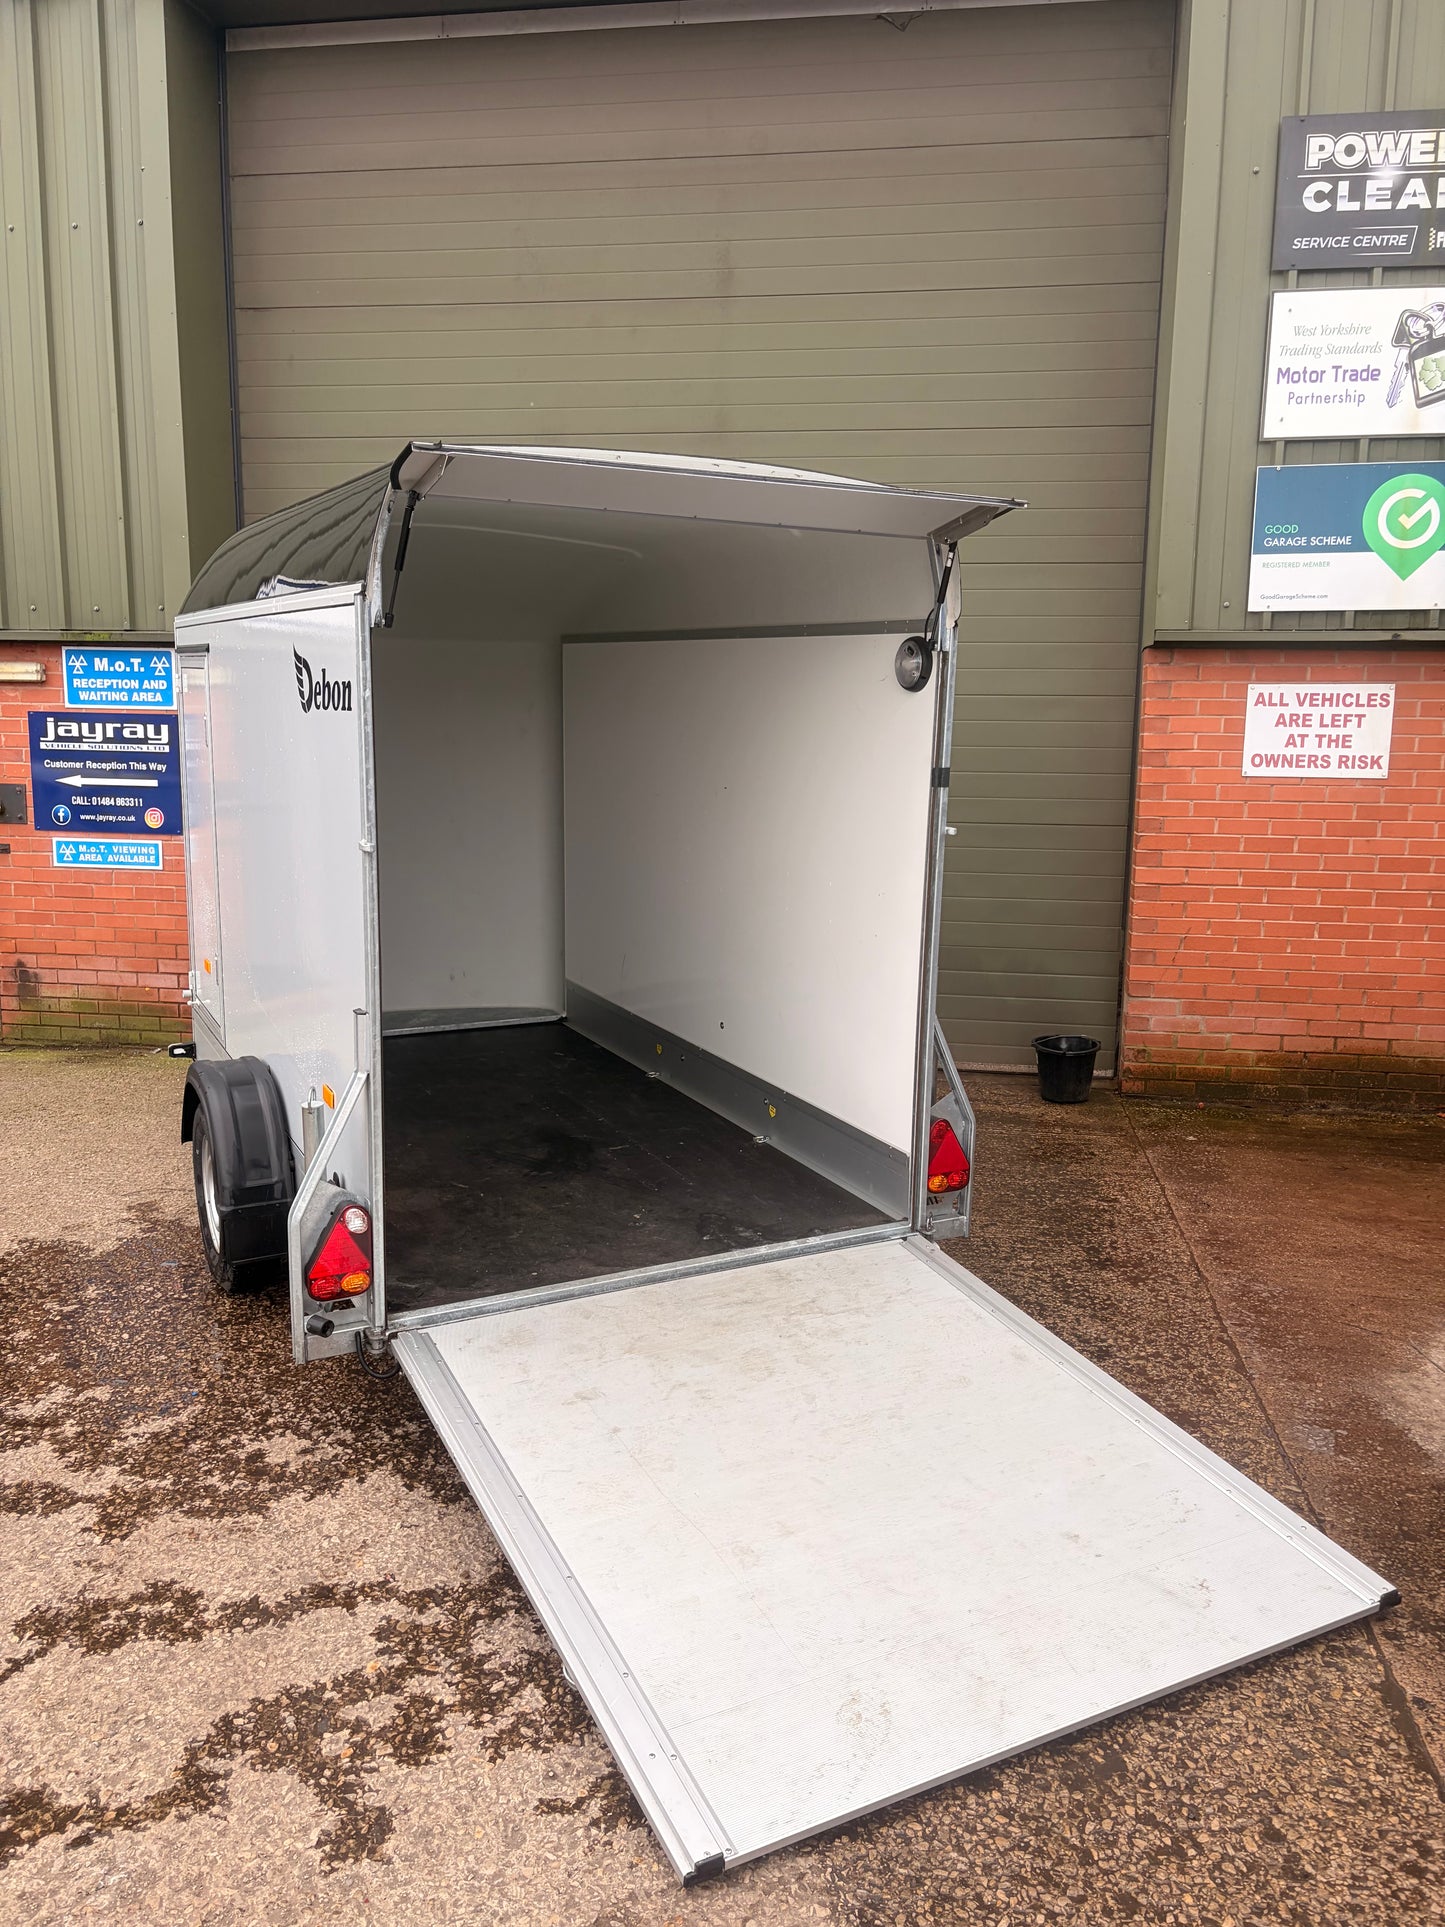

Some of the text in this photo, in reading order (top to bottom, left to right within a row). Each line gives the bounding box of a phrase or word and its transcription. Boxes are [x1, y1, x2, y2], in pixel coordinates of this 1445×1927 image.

[1292, 234, 1408, 249] SERVICE CENTRE
[1293, 323, 1372, 337] West Yorkshire
[1279, 341, 1383, 359] Trading Standards
[1276, 364, 1381, 384] Motor Trade
[1287, 388, 1366, 407] Partnership
[1264, 525, 1299, 534] GOOD
[1263, 535, 1352, 547] GARAGE SCHEME
[94, 657, 145, 672] M.o.T.
[73, 678, 167, 690] RECEPTION AND
[293, 642, 352, 714] Debon
[78, 690, 163, 702] WAITING AREA
[1254, 692, 1391, 708] ALL VEHICLES
[1274, 713, 1366, 728] ARE LEFT
[40, 717, 169, 744] jayray
[1284, 733, 1353, 749] AT THE
[44, 759, 167, 773] Customer Reception This Way
[1250, 753, 1384, 770] OWNERS RISK
[71, 795, 143, 807] CALL: 01484 863311
[79, 813, 136, 822] www.jayray.co.uk
[79, 844, 155, 854] M.o.T. VIEWING
[79, 853, 155, 863] AREA AVAILABLE
